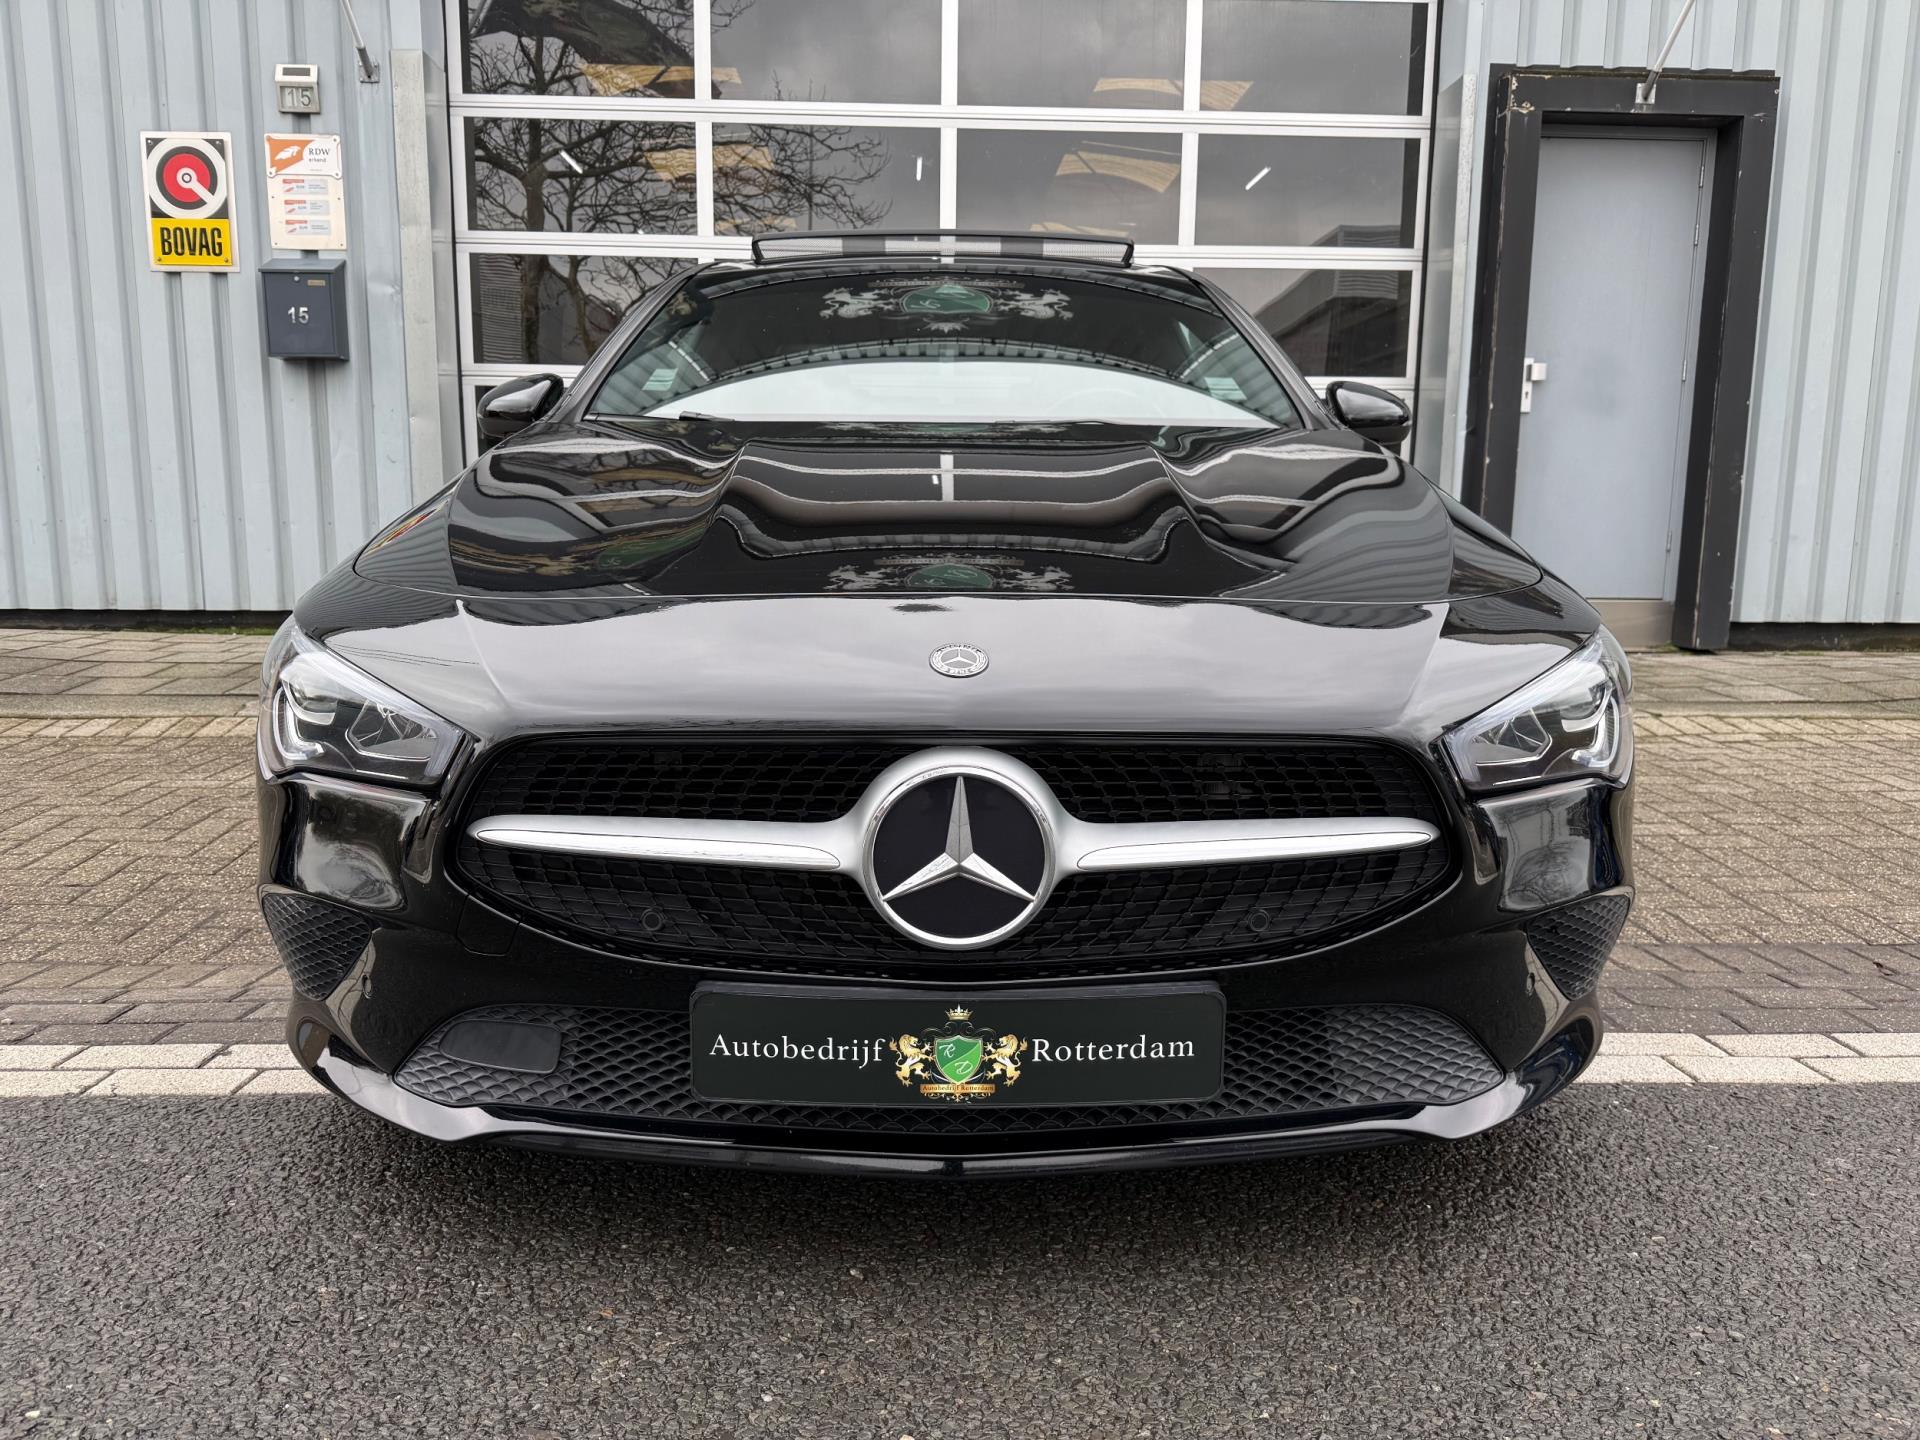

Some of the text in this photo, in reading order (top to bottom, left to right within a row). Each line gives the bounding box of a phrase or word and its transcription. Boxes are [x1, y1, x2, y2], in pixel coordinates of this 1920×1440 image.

[287, 88, 311, 107] 15
[308, 148, 331, 156] RDW
[160, 226, 223, 257] BOVAG
[287, 306, 309, 324] 15
[709, 1033, 1195, 1070] Autobedrijf Rotterdam
[922, 1085, 960, 1093] Autobedrijf
